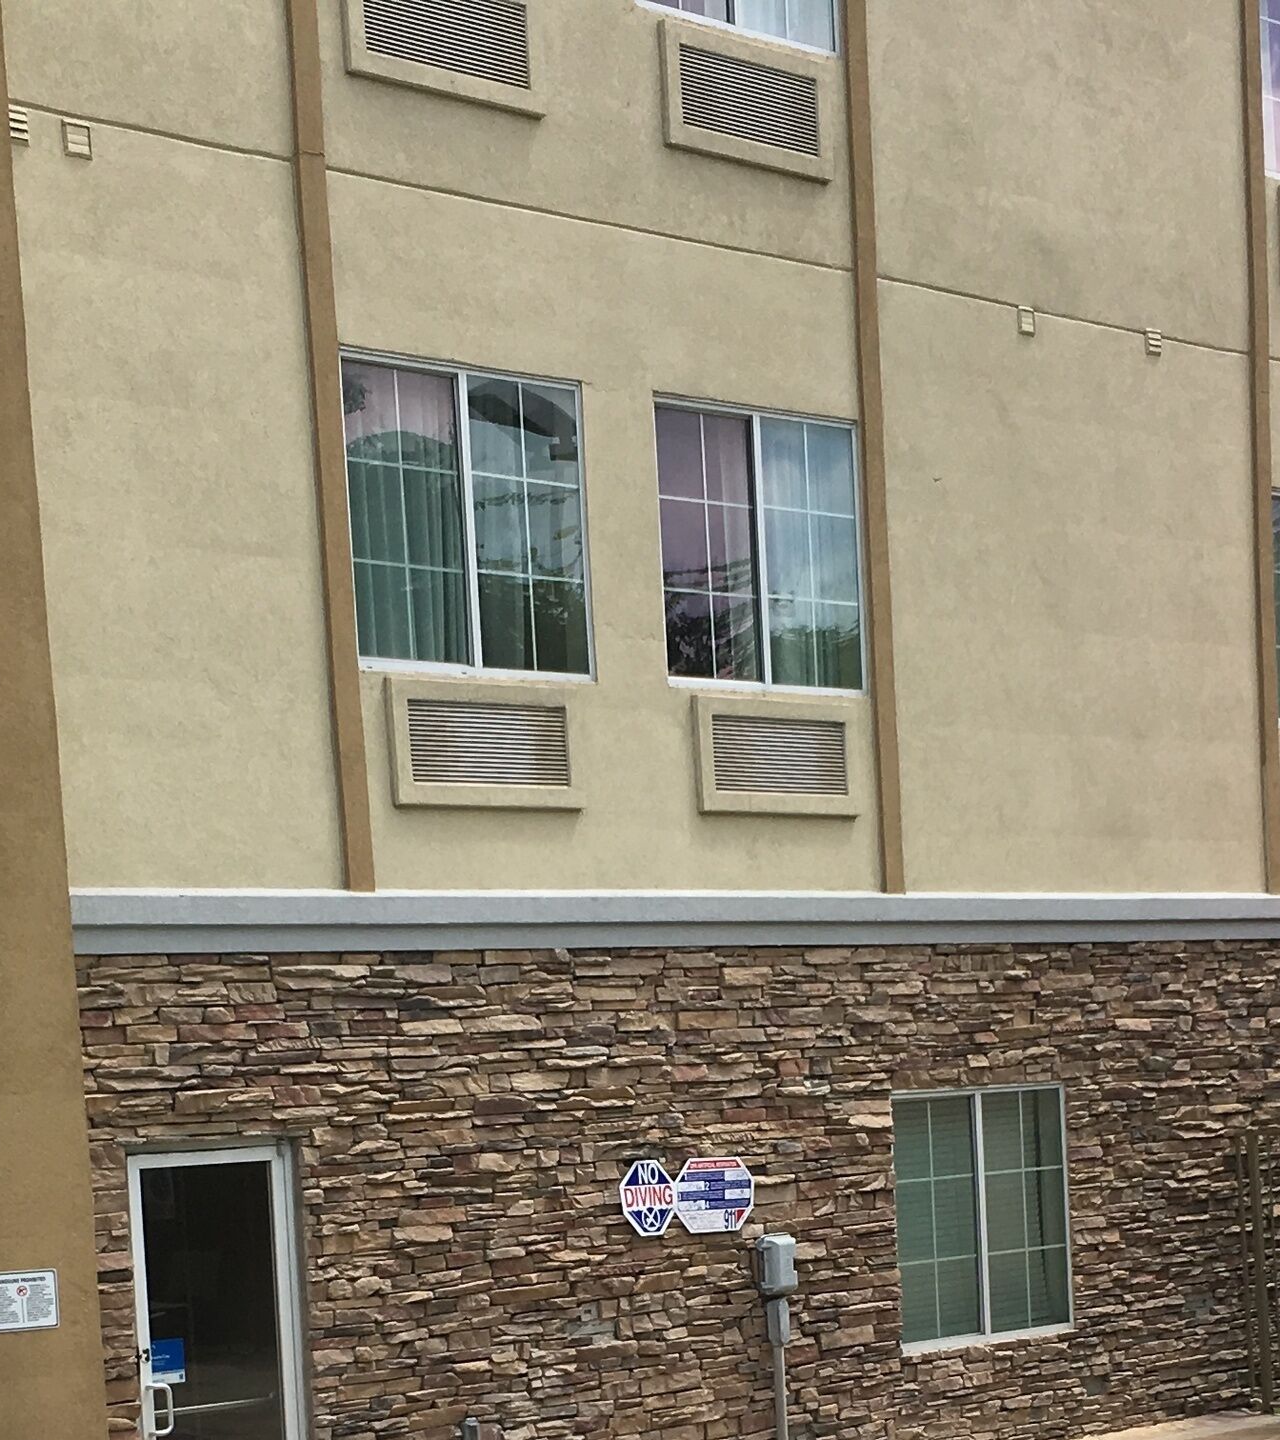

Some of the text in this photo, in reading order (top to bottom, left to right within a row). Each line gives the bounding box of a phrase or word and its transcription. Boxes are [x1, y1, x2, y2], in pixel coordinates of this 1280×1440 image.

[637, 1163, 658, 1184] NO
[624, 1185, 673, 1208] DIVING
[724, 1209, 737, 1229] 911
